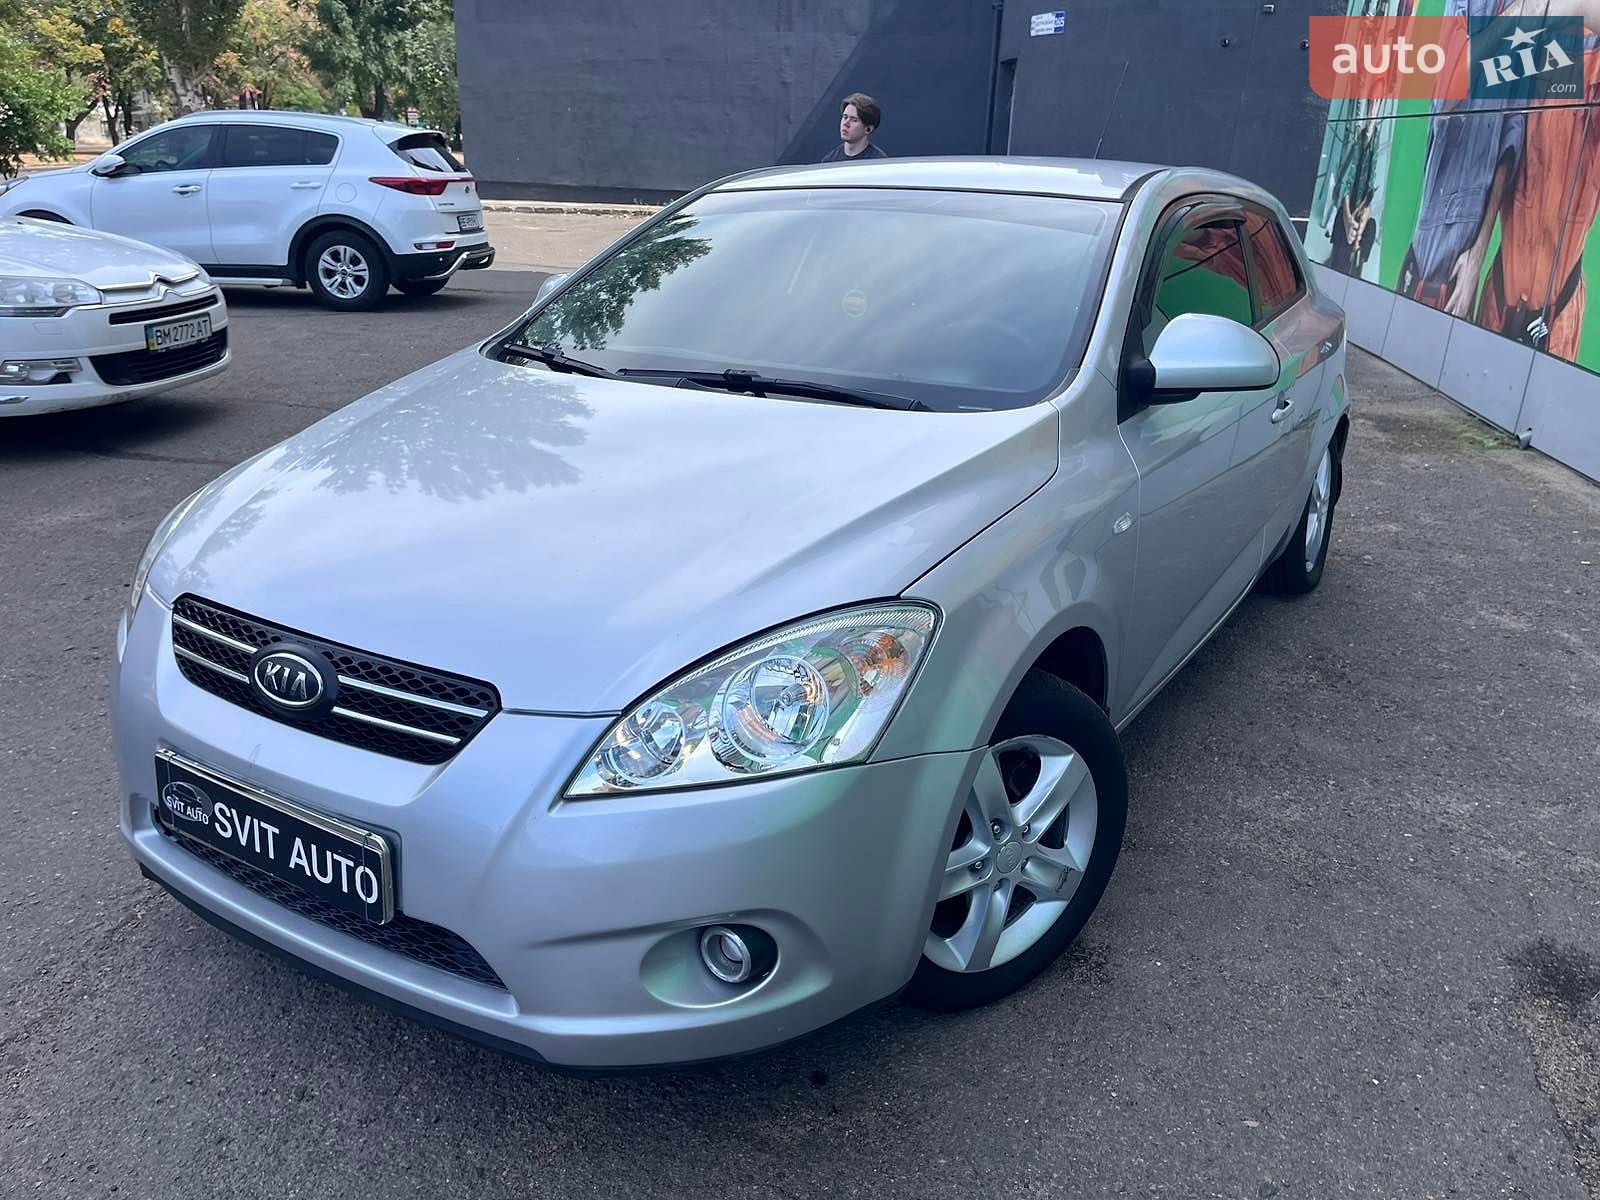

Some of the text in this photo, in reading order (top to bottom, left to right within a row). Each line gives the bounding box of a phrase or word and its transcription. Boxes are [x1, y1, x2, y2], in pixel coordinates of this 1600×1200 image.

[263, 661, 308, 700] KIA
[166, 795, 209, 825] SVIT AUTO
[213, 801, 379, 904] SVIT AUTO
